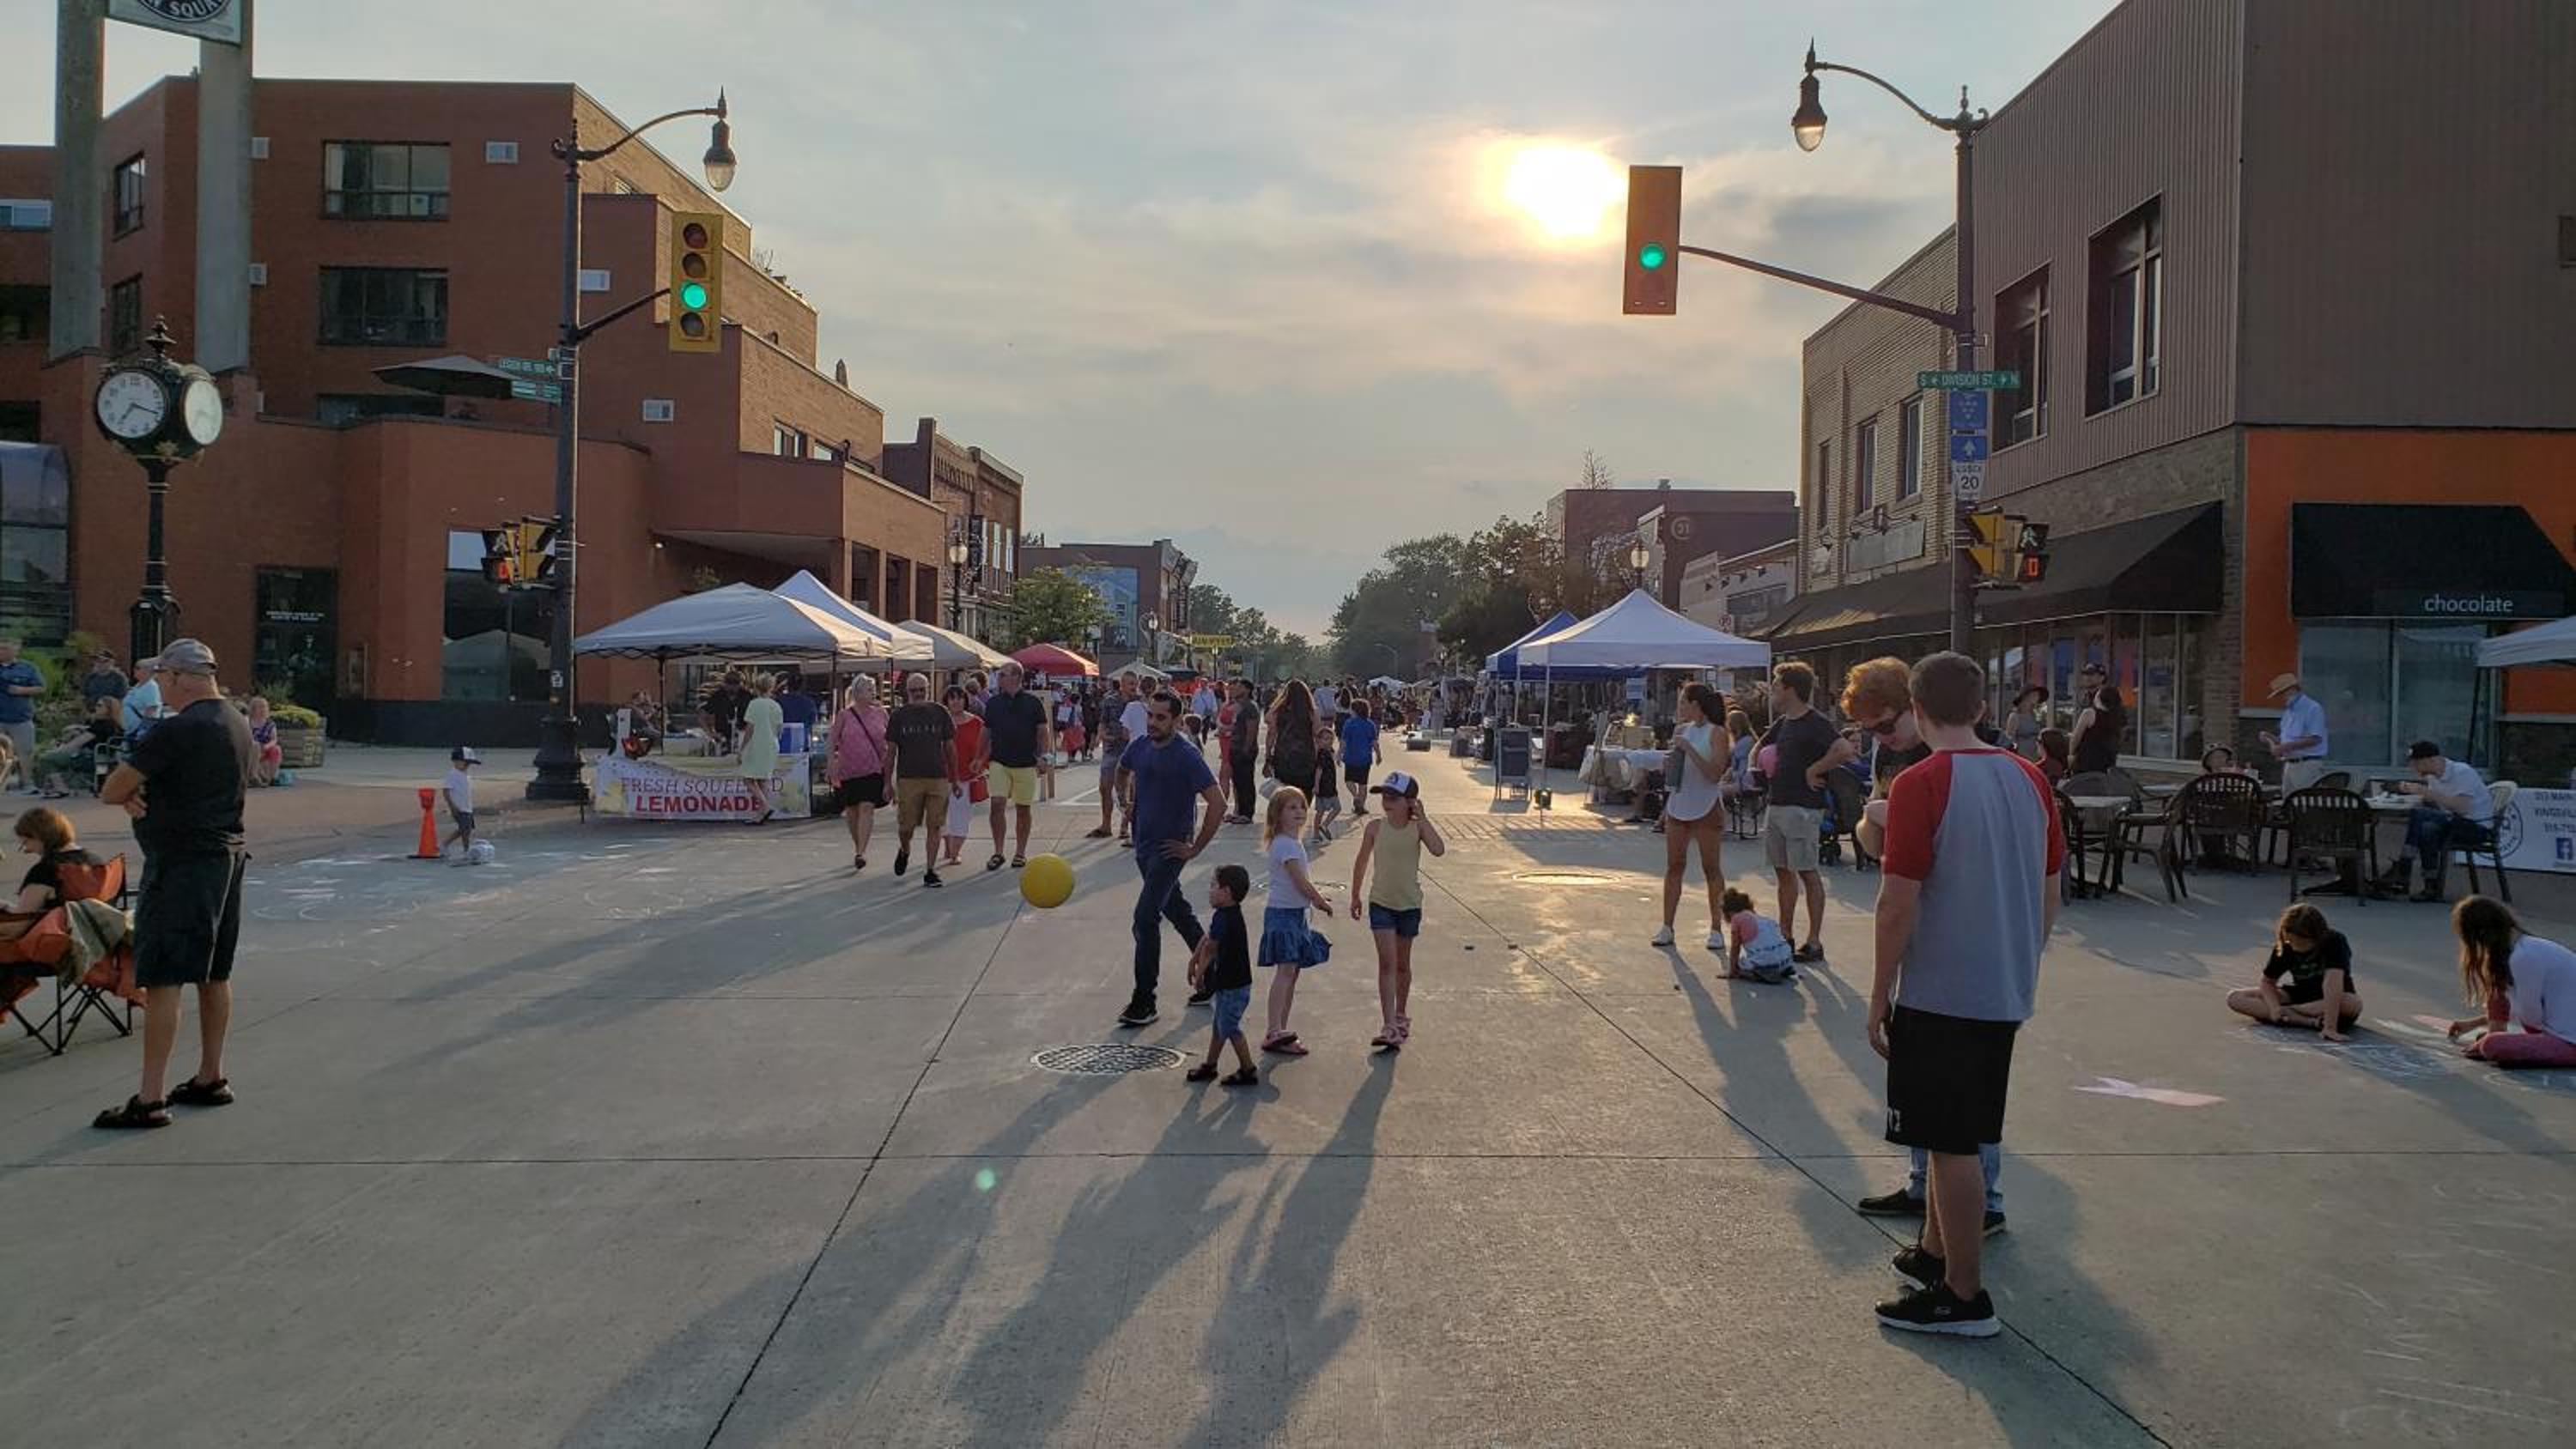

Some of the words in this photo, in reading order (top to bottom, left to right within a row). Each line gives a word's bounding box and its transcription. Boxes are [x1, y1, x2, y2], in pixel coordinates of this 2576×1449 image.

[1960, 475, 1979, 490] 20
[2424, 593, 2514, 613] chocolate
[620, 777, 678, 793] FRESH
